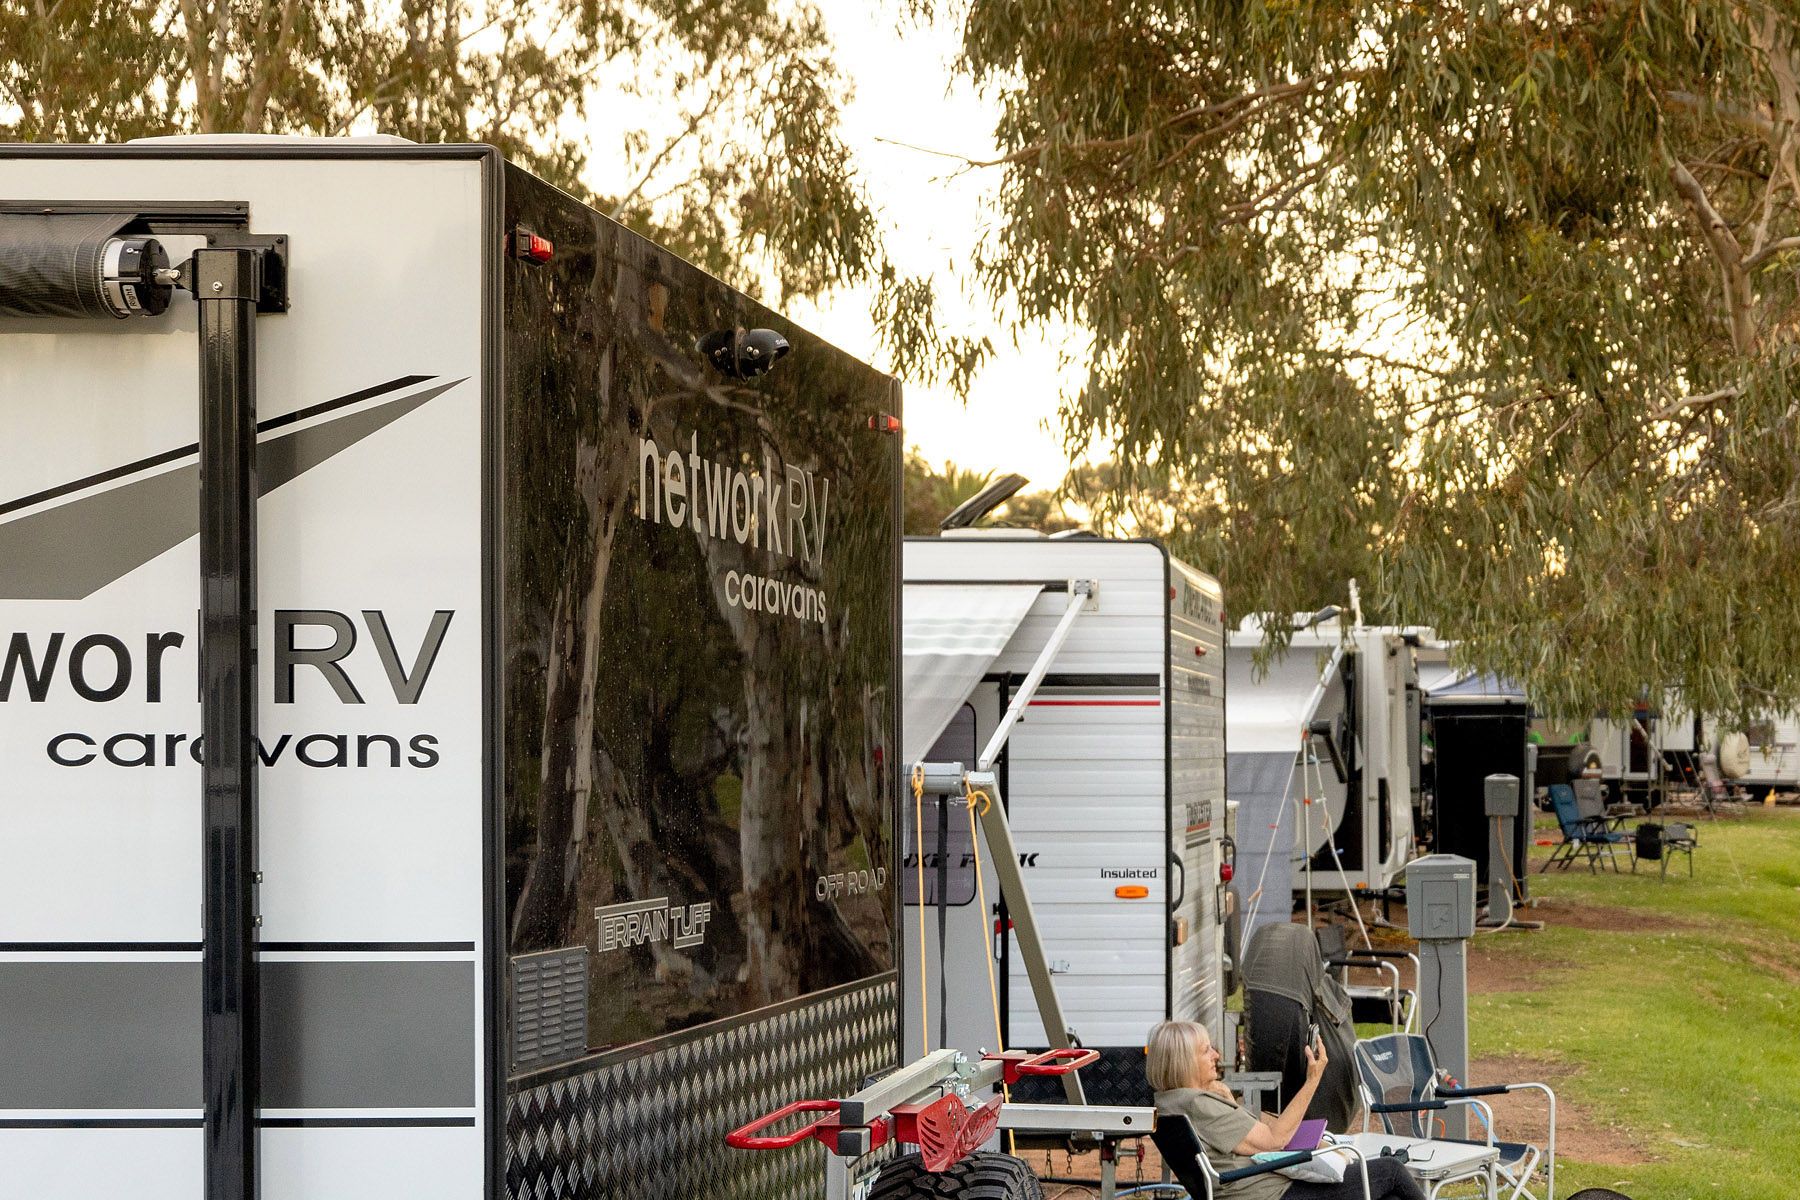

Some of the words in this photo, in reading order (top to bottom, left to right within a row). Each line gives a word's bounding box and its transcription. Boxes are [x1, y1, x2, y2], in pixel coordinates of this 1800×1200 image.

[725, 569, 827, 624] caravans
[46, 732, 441, 769] carvans
[816, 873, 844, 902] OFF
[847, 867, 886, 896] ROAD
[1100, 868, 1157, 879] Insulated
[594, 896, 669, 953] TERRAIN
[670, 901, 711, 949] TUFF
